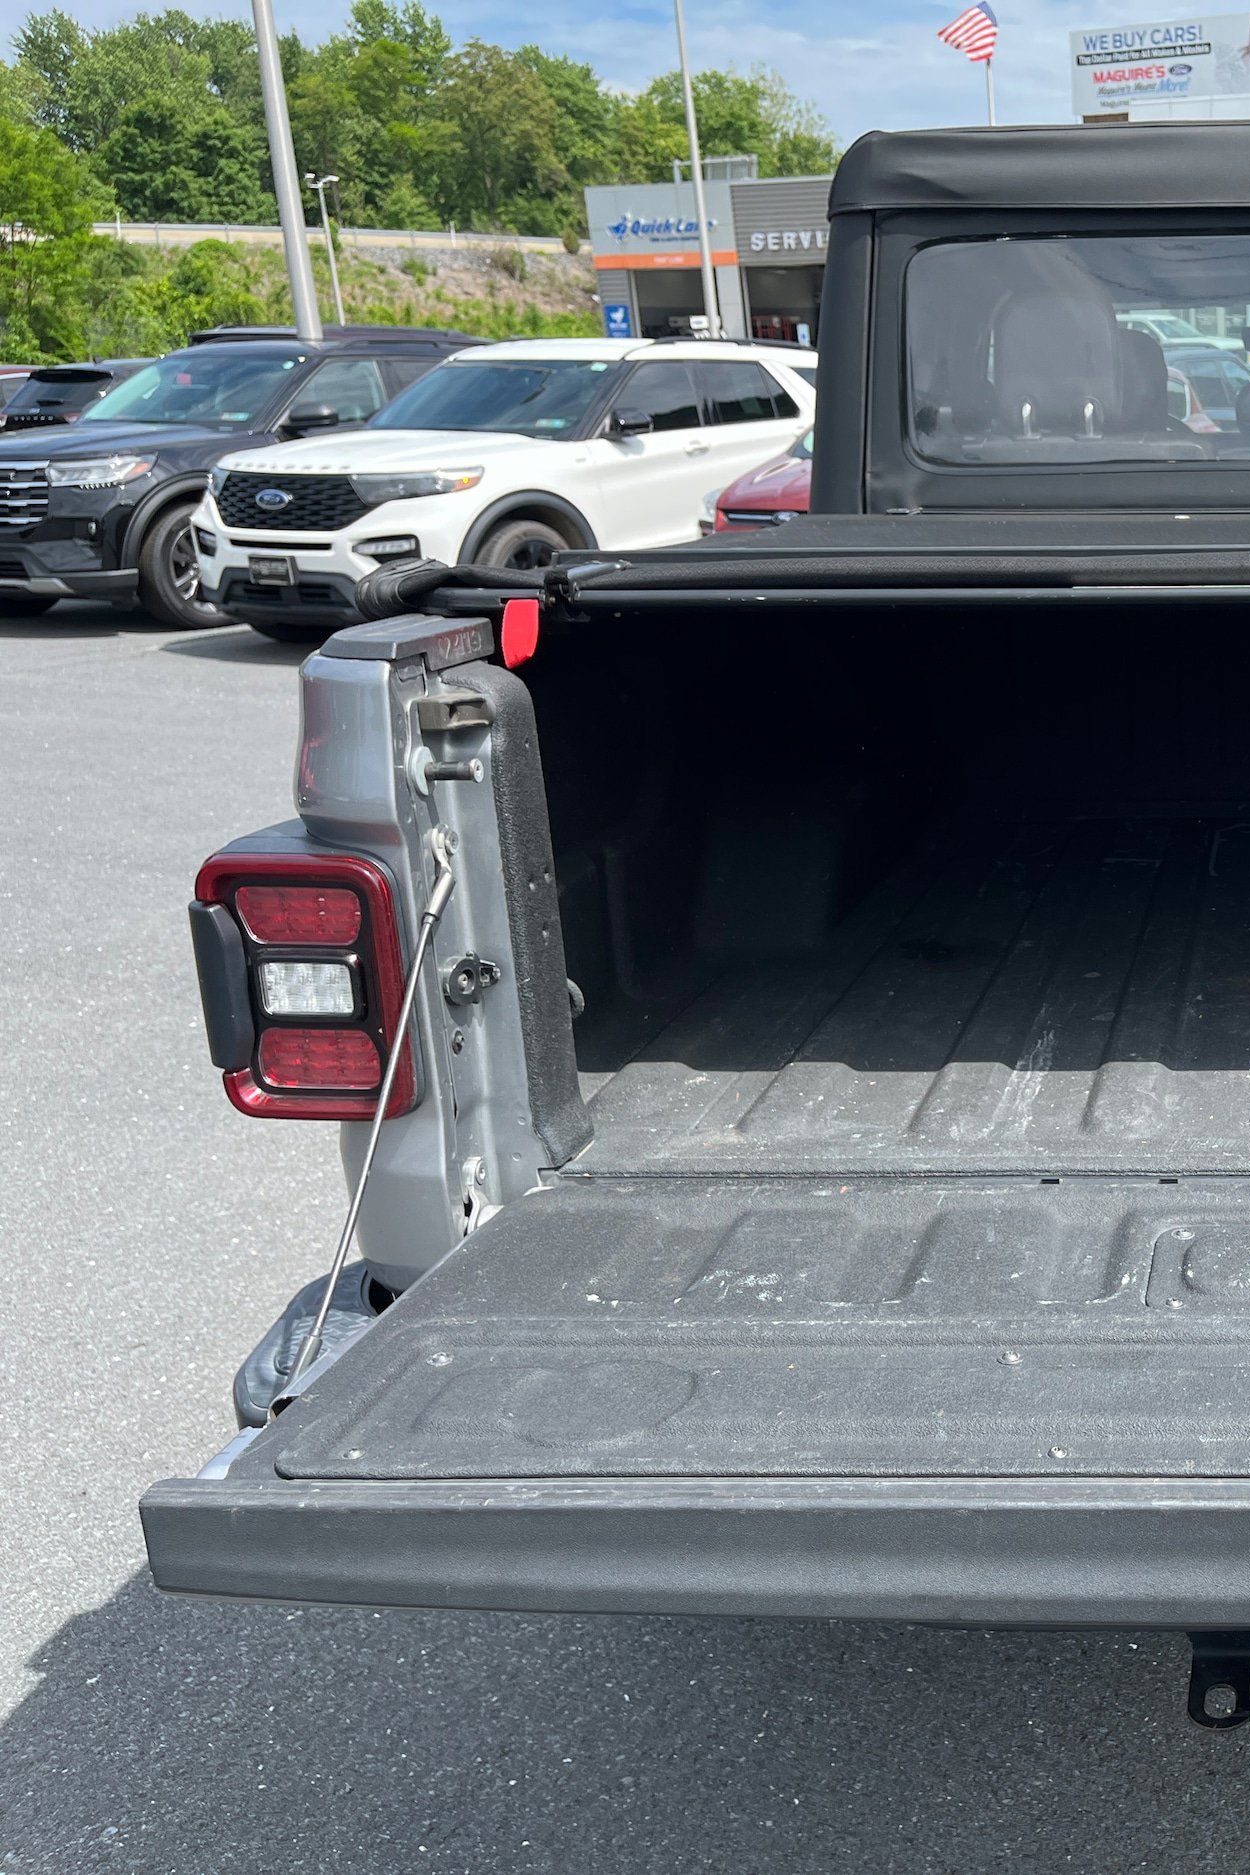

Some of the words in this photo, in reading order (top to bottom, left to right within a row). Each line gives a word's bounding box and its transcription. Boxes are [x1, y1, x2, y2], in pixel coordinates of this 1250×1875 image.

[1083, 35, 1109, 51] WE
[1113, 30, 1147, 49] BUY
[1150, 25, 1202, 45] CARS!
[1093, 64, 1166, 83] MAGUIRE'S
[631, 219, 671, 235] Quick
[751, 231, 829, 251] SERVI
